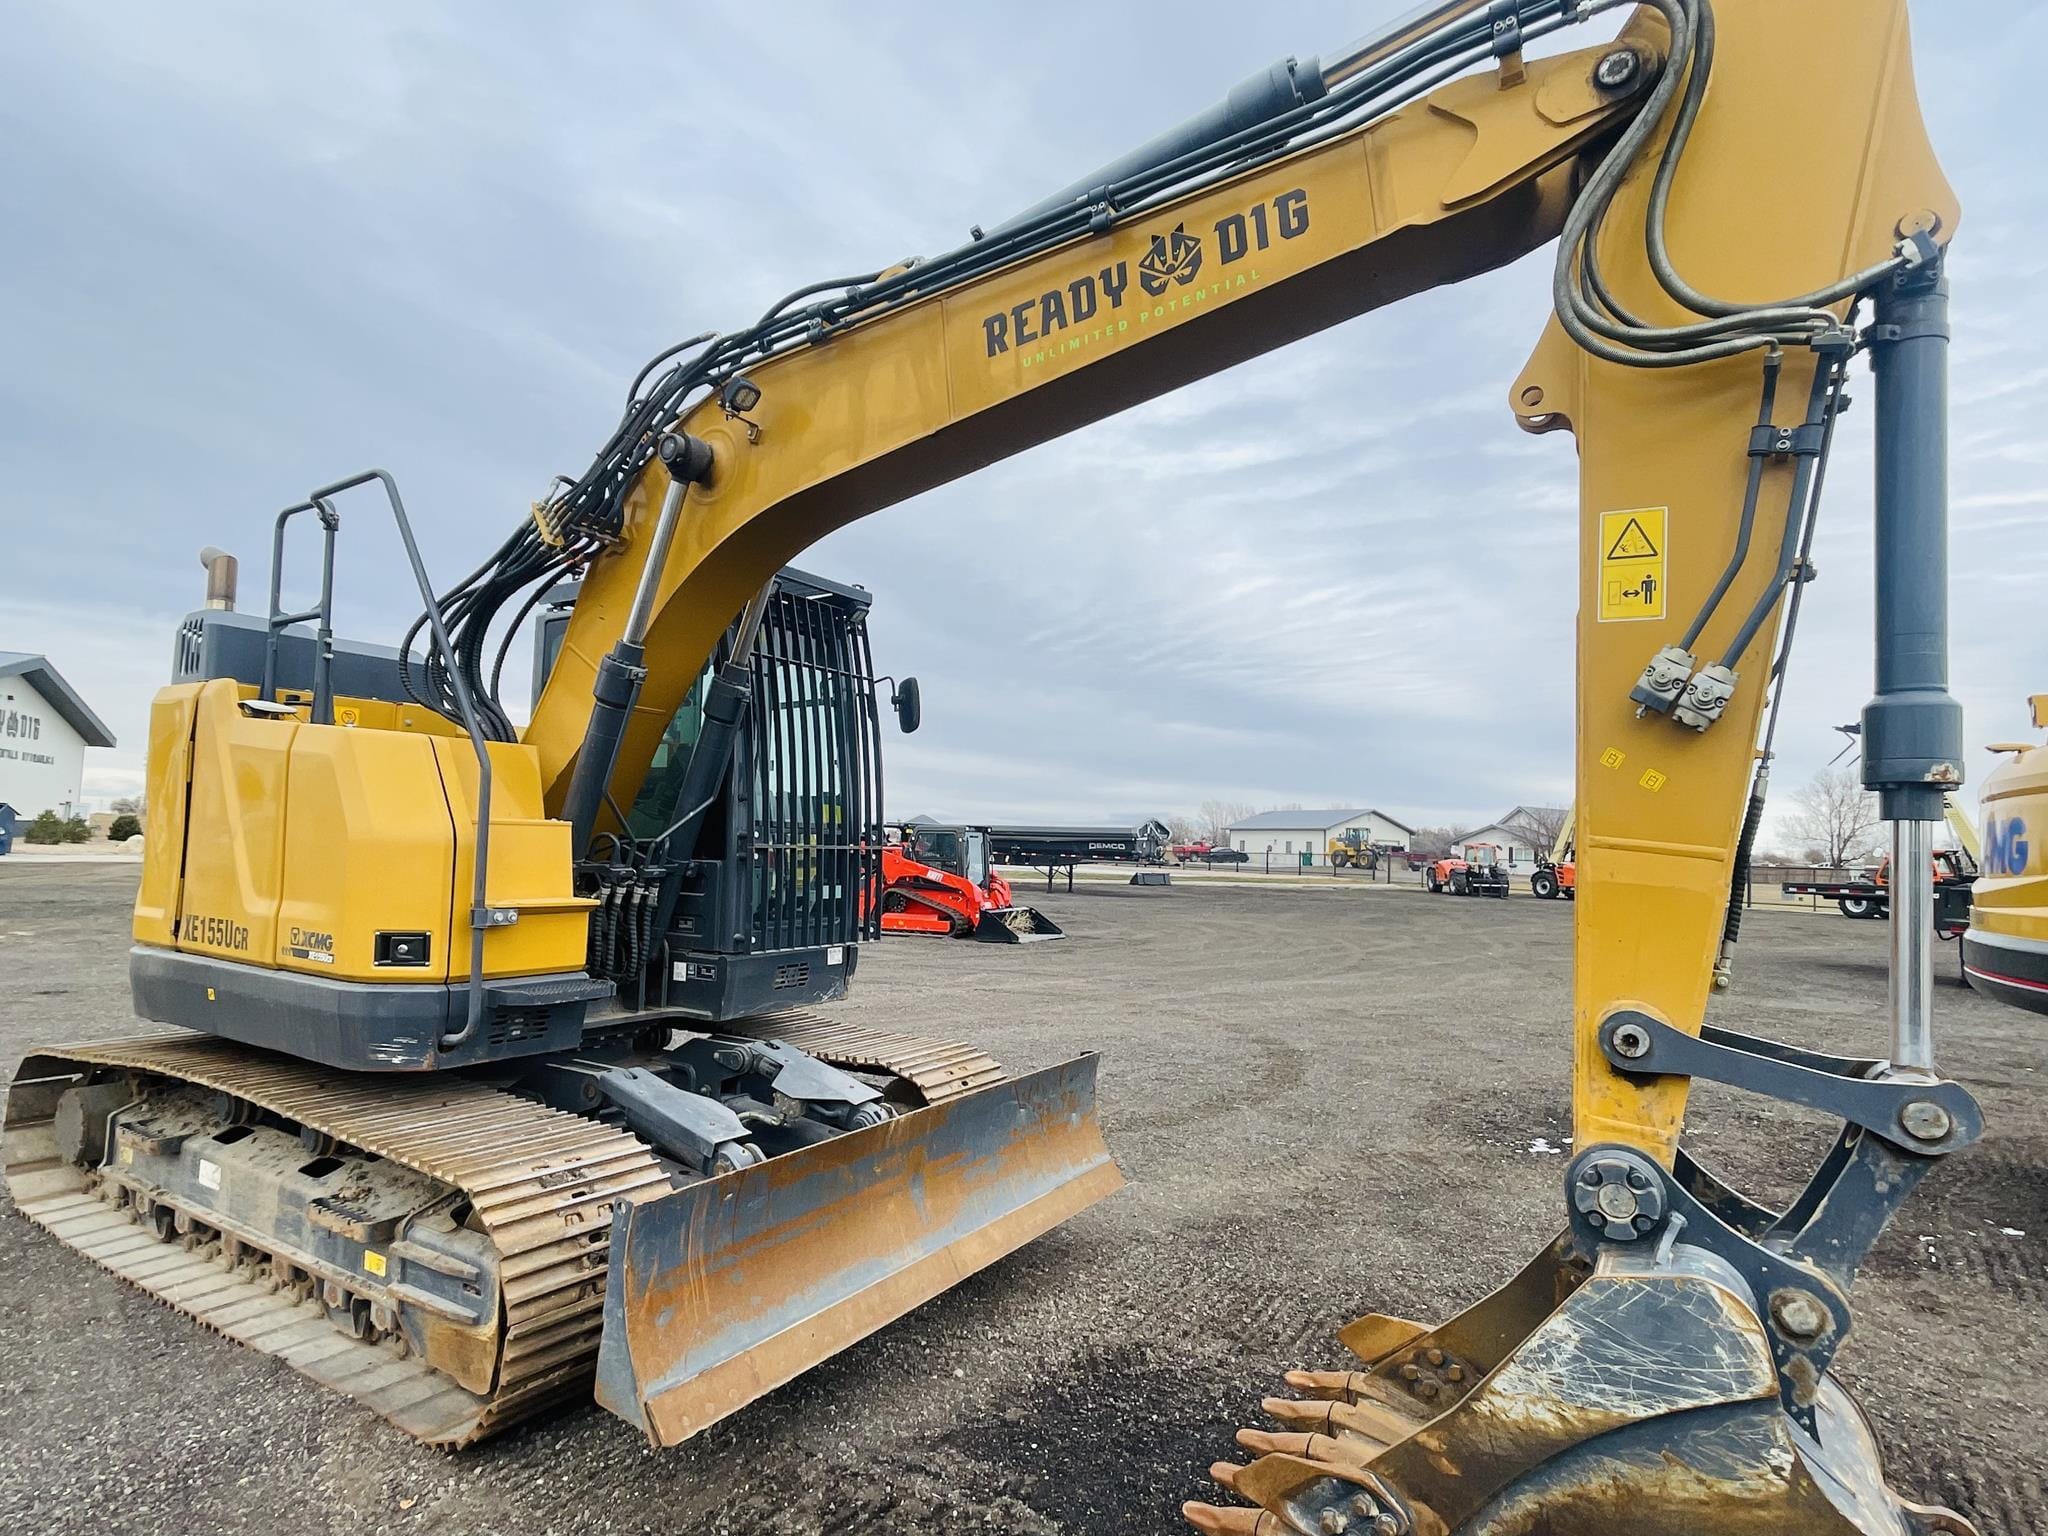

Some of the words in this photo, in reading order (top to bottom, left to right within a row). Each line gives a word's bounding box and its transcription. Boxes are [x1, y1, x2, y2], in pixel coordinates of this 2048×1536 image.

[983, 260, 1129, 358] READY
[1023, 319, 1129, 368] UNLIMITED
[1140, 269, 1262, 323] POTENTIAL
[1088, 842, 1126, 850] DEMCO
[184, 914, 250, 951] XE155UCR
[301, 929, 334, 952] XCMG
